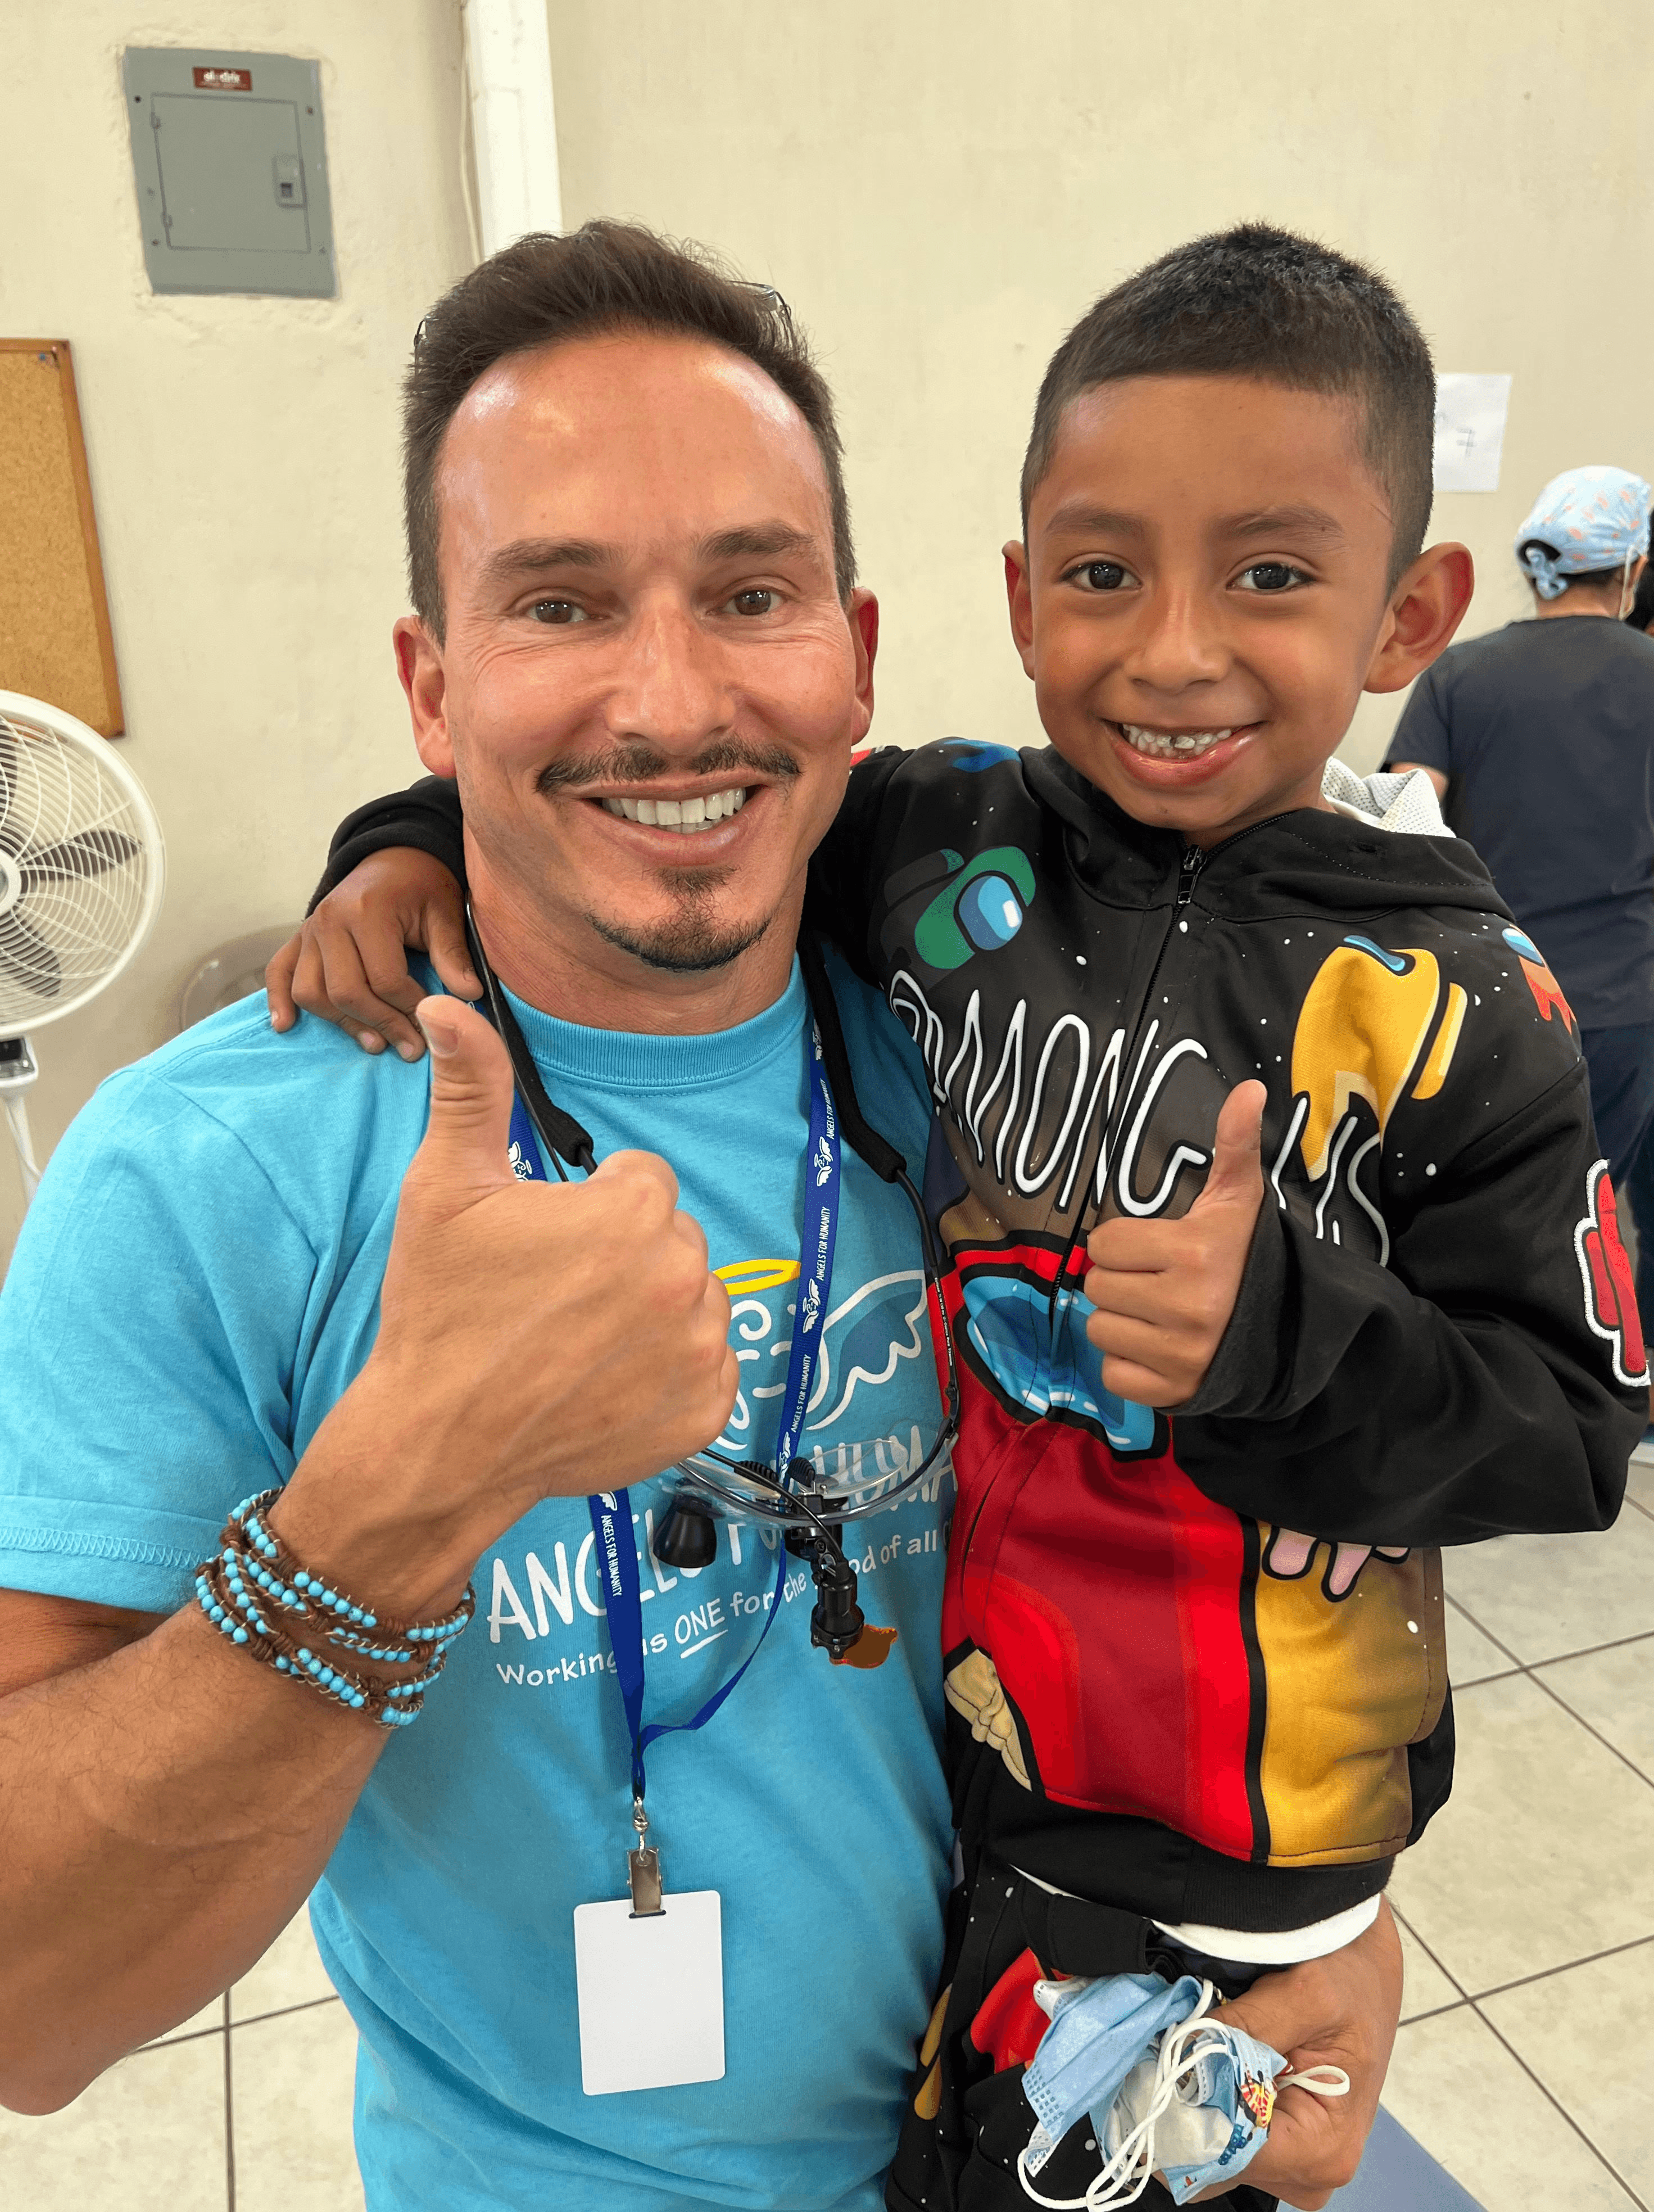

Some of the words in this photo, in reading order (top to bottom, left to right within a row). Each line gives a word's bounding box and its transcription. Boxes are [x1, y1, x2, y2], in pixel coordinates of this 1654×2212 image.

[826, 1115, 835, 1140] ANGELS
[818, 1206, 831, 1240] HUMANITY
[818, 1240, 828, 1254] FOR
[815, 1254, 827, 1281] ANGELS
[800, 1354, 812, 1390] HUMANITY
[797, 1391, 806, 1405] FOR
[791, 1405, 804, 1433] ANGELS
[487, 1509, 703, 1643] ANGL
[813, 1425, 959, 1511] HUMA
[601, 1515, 615, 1544] ANGELS
[606, 1542, 618, 1560] FOR
[608, 1558, 622, 1597] HUMANITY
[674, 1598, 725, 1643] ONE
[730, 1591, 775, 1616] for
[783, 1572, 806, 1603] the
[881, 1534, 901, 1564] of
[907, 1529, 937, 1555] all
